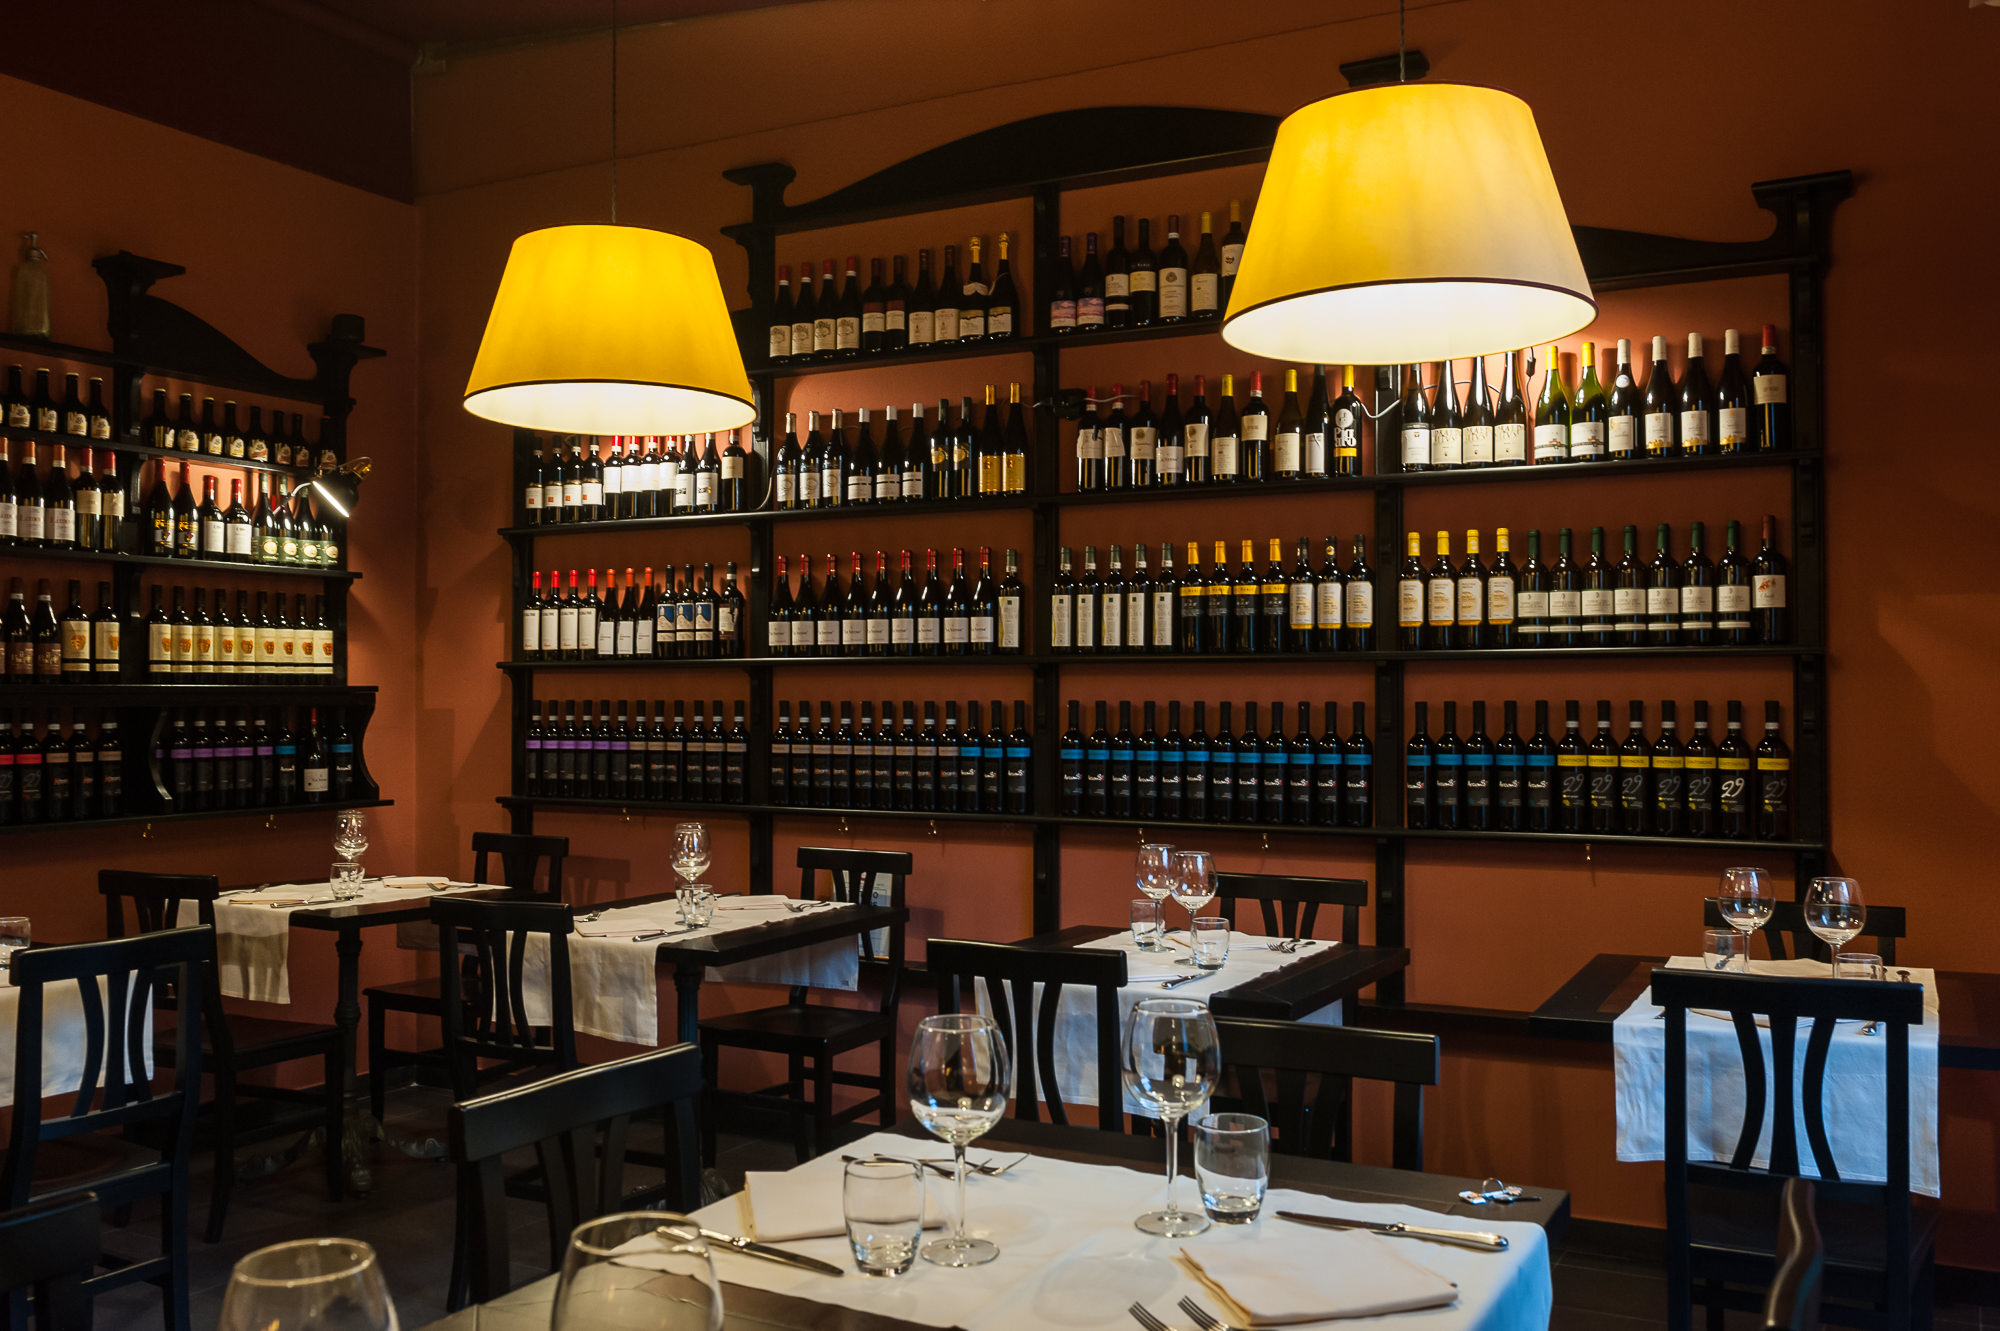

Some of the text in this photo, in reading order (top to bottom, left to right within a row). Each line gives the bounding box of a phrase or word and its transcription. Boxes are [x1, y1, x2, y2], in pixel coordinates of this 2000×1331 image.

[1562, 773, 1585, 793] 29
[1591, 774, 1613, 794] 29
[1622, 774, 1644, 794] 29
[1658, 775, 1682, 796] 29
[1688, 776, 1712, 797] 29
[1720, 777, 1745, 798] 29
